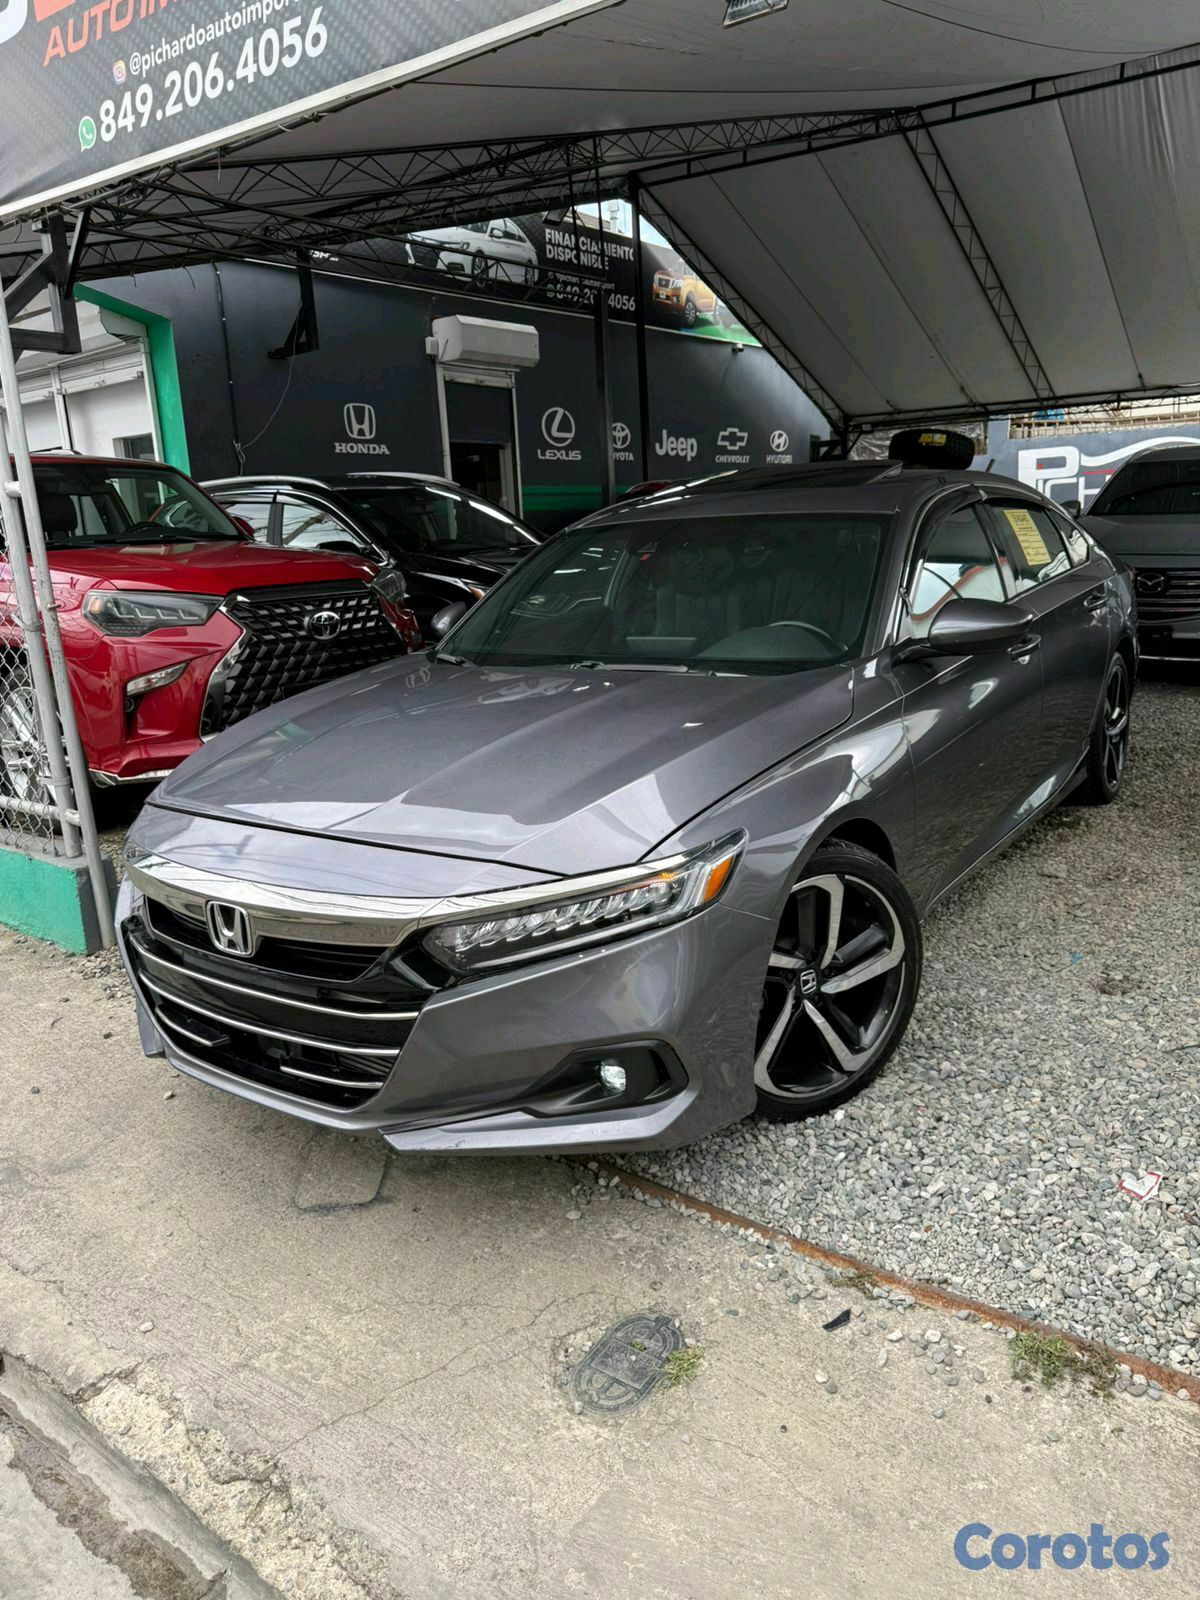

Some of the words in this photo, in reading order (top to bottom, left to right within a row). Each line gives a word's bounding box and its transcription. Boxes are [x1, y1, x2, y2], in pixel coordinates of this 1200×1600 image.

[100, 6, 328, 142] 849.206.4056
[334, 442, 390, 455] HONDA
[655, 429, 698, 462] Jeep
[537, 449, 582, 460] LEXUS
[715, 454, 751, 464] CHEVROLET
